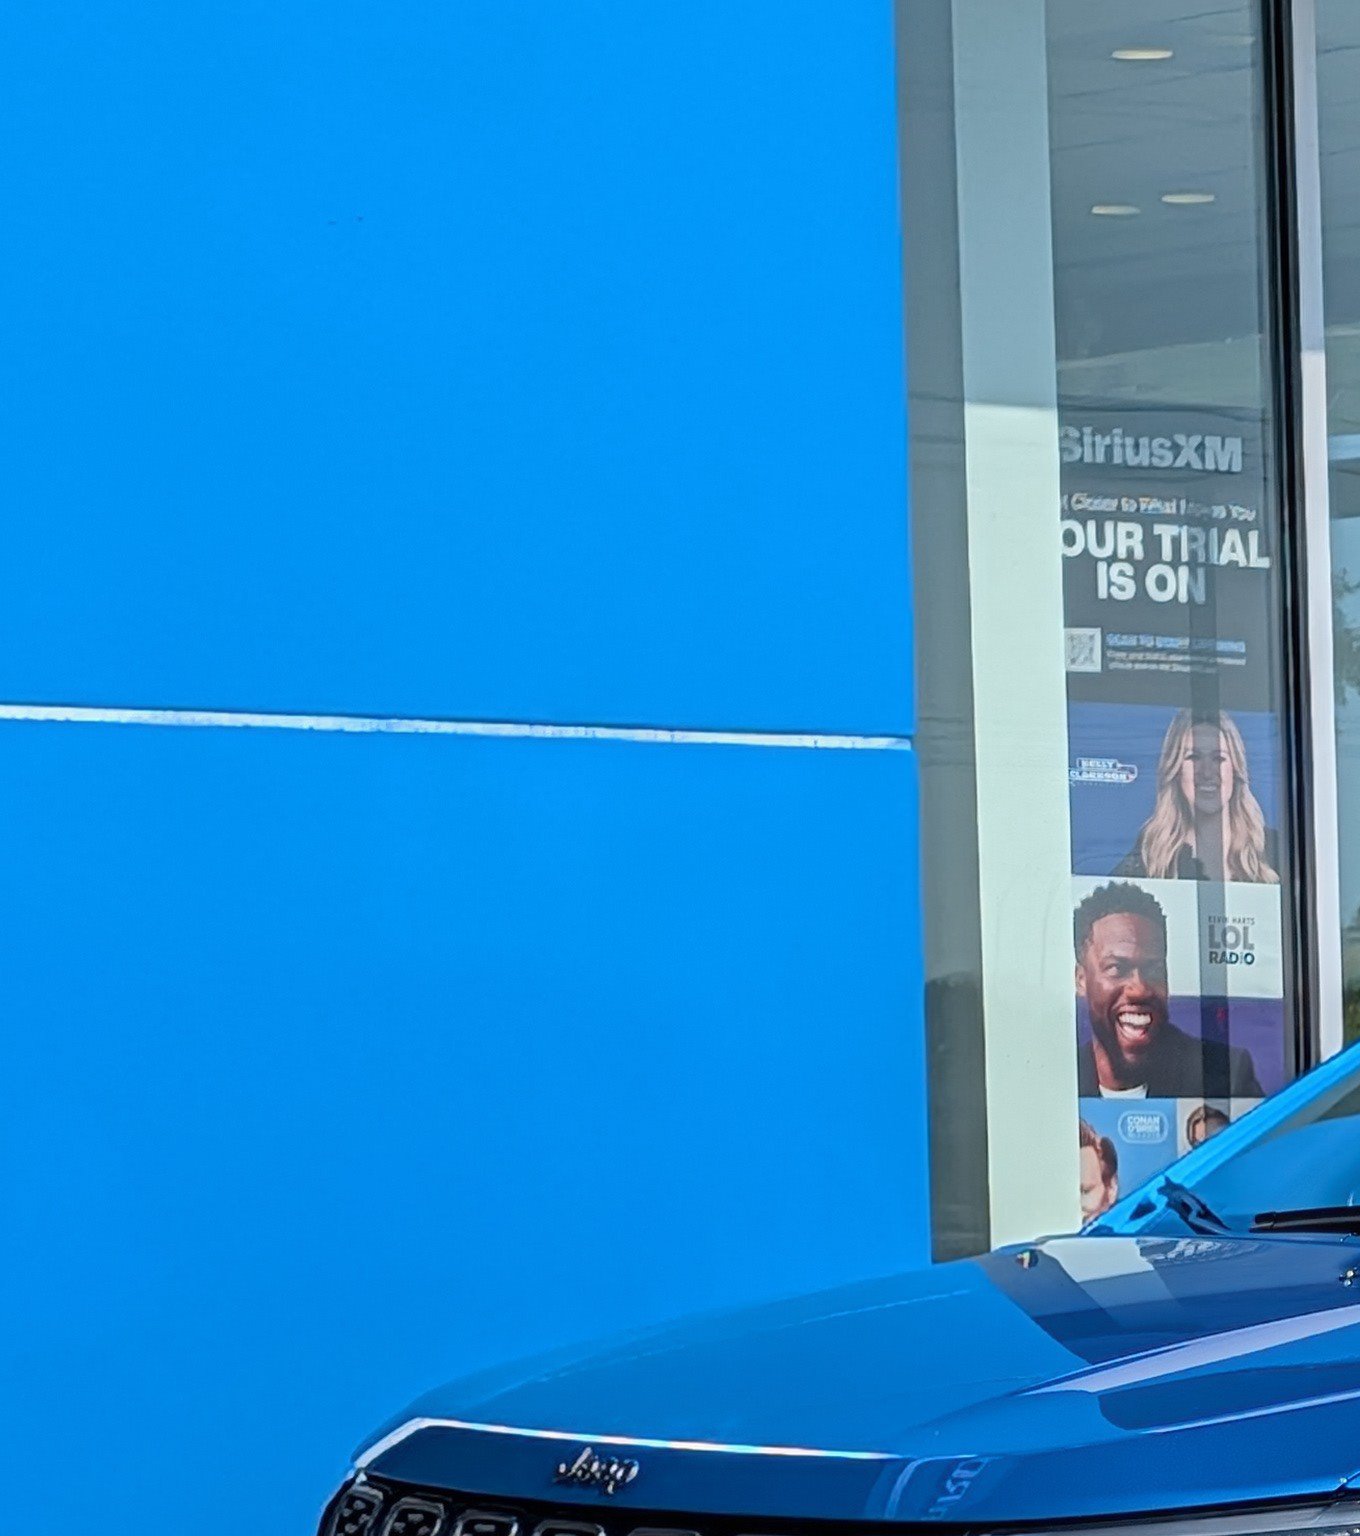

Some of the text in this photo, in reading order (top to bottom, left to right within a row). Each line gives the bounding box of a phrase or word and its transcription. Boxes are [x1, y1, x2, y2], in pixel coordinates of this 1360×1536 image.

[1060, 426, 1242, 472] SiriusXM
[1061, 519, 1270, 569] OUR TRIAL
[1097, 560, 1206, 605] IS ON
[1208, 924, 1255, 950] LOL
[1209, 951, 1255, 965] RADIO
